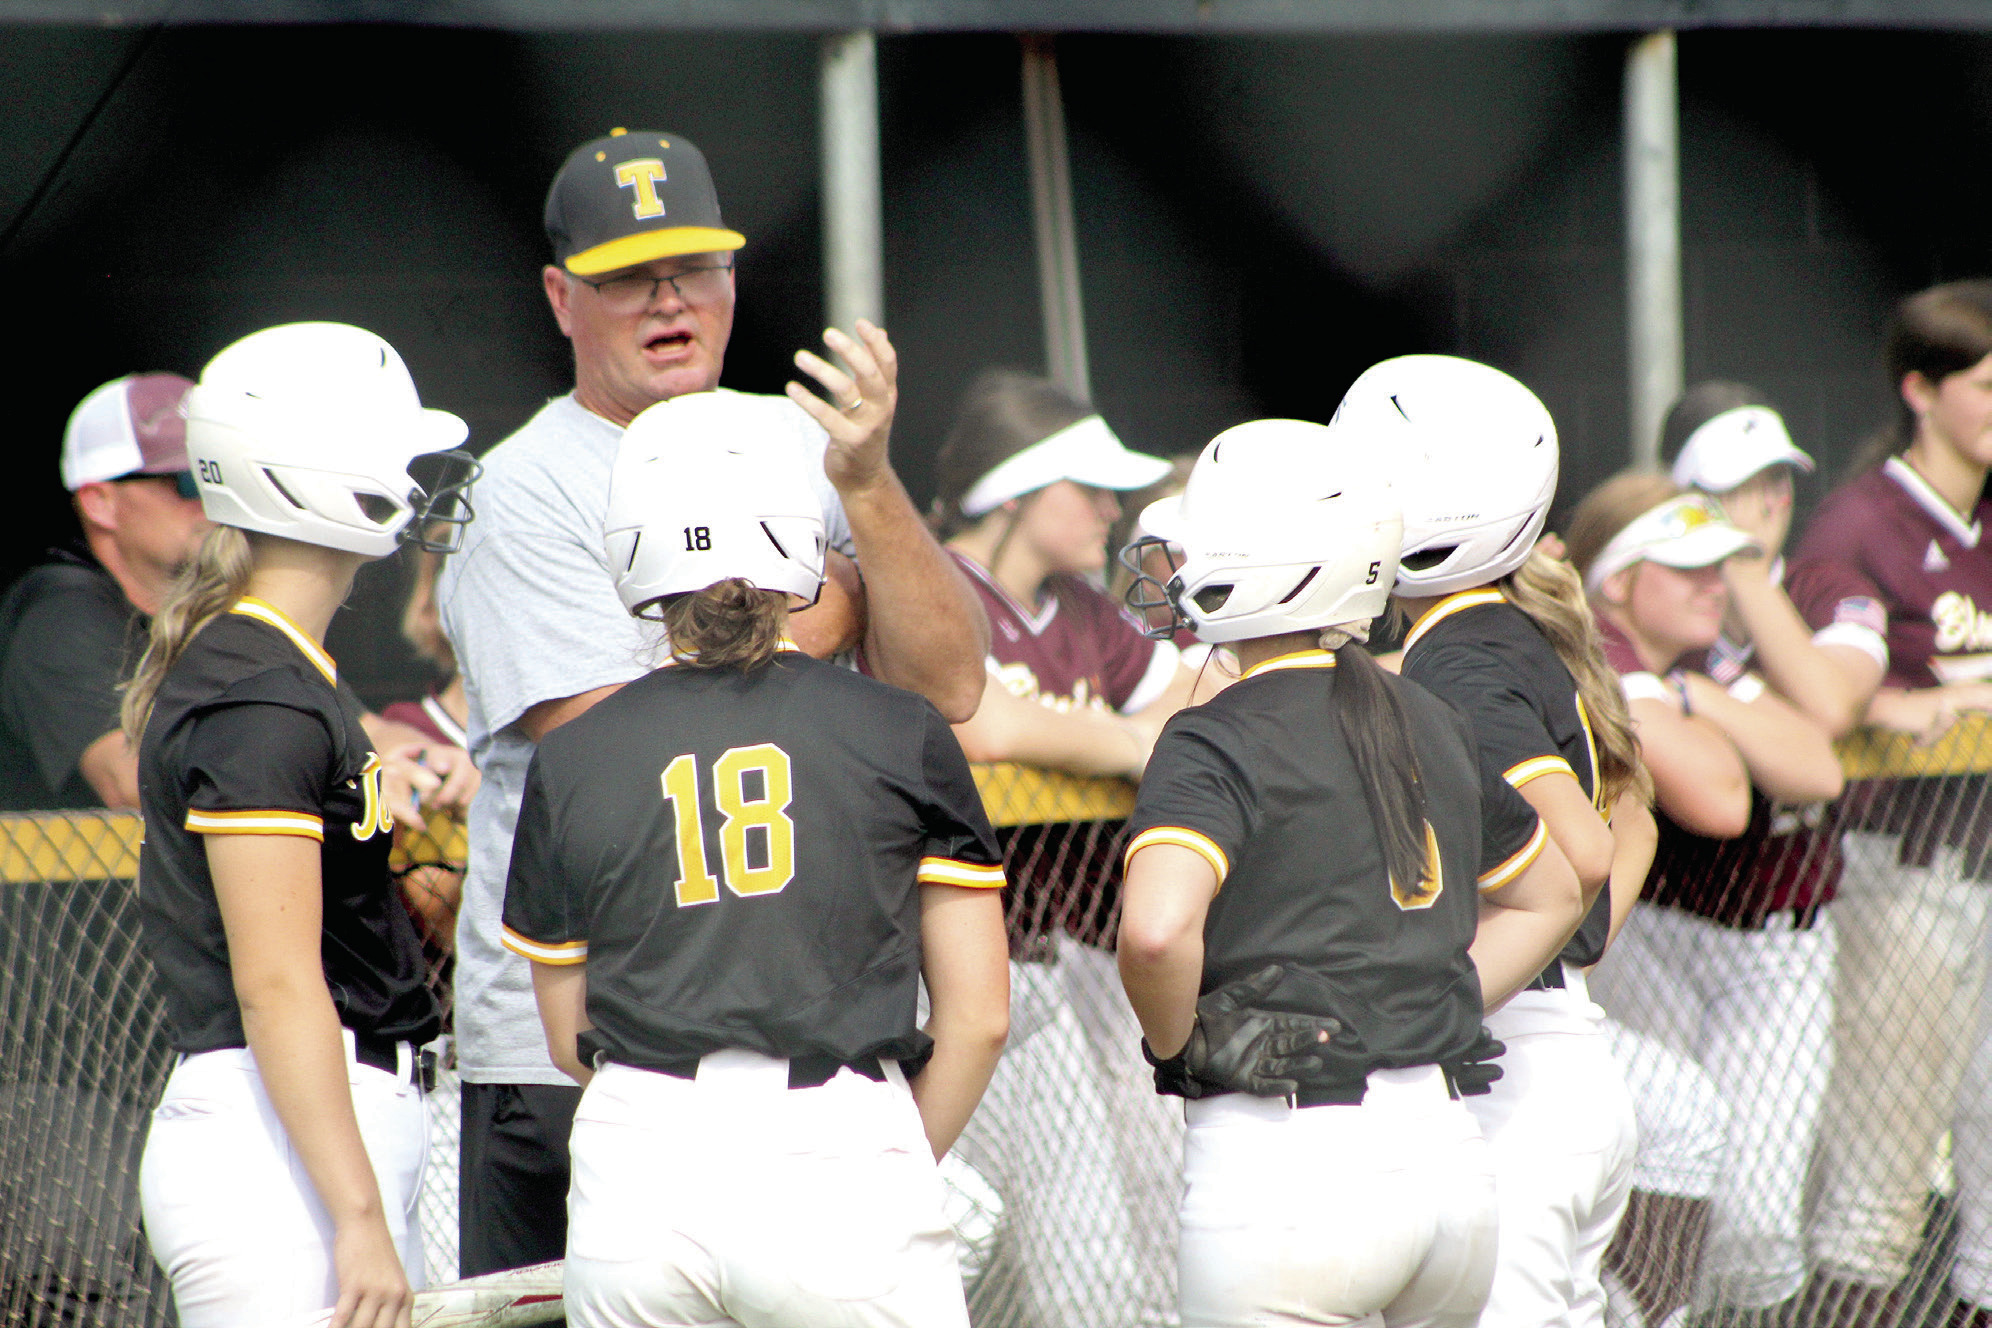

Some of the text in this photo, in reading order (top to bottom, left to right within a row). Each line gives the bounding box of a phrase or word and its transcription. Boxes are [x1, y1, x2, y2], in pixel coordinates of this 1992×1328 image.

[613, 158, 667, 220] T
[199, 459, 223, 484] 20
[684, 526, 712, 551] 18
[1366, 561, 1381, 585] 5
[660, 743, 796, 908] 18
